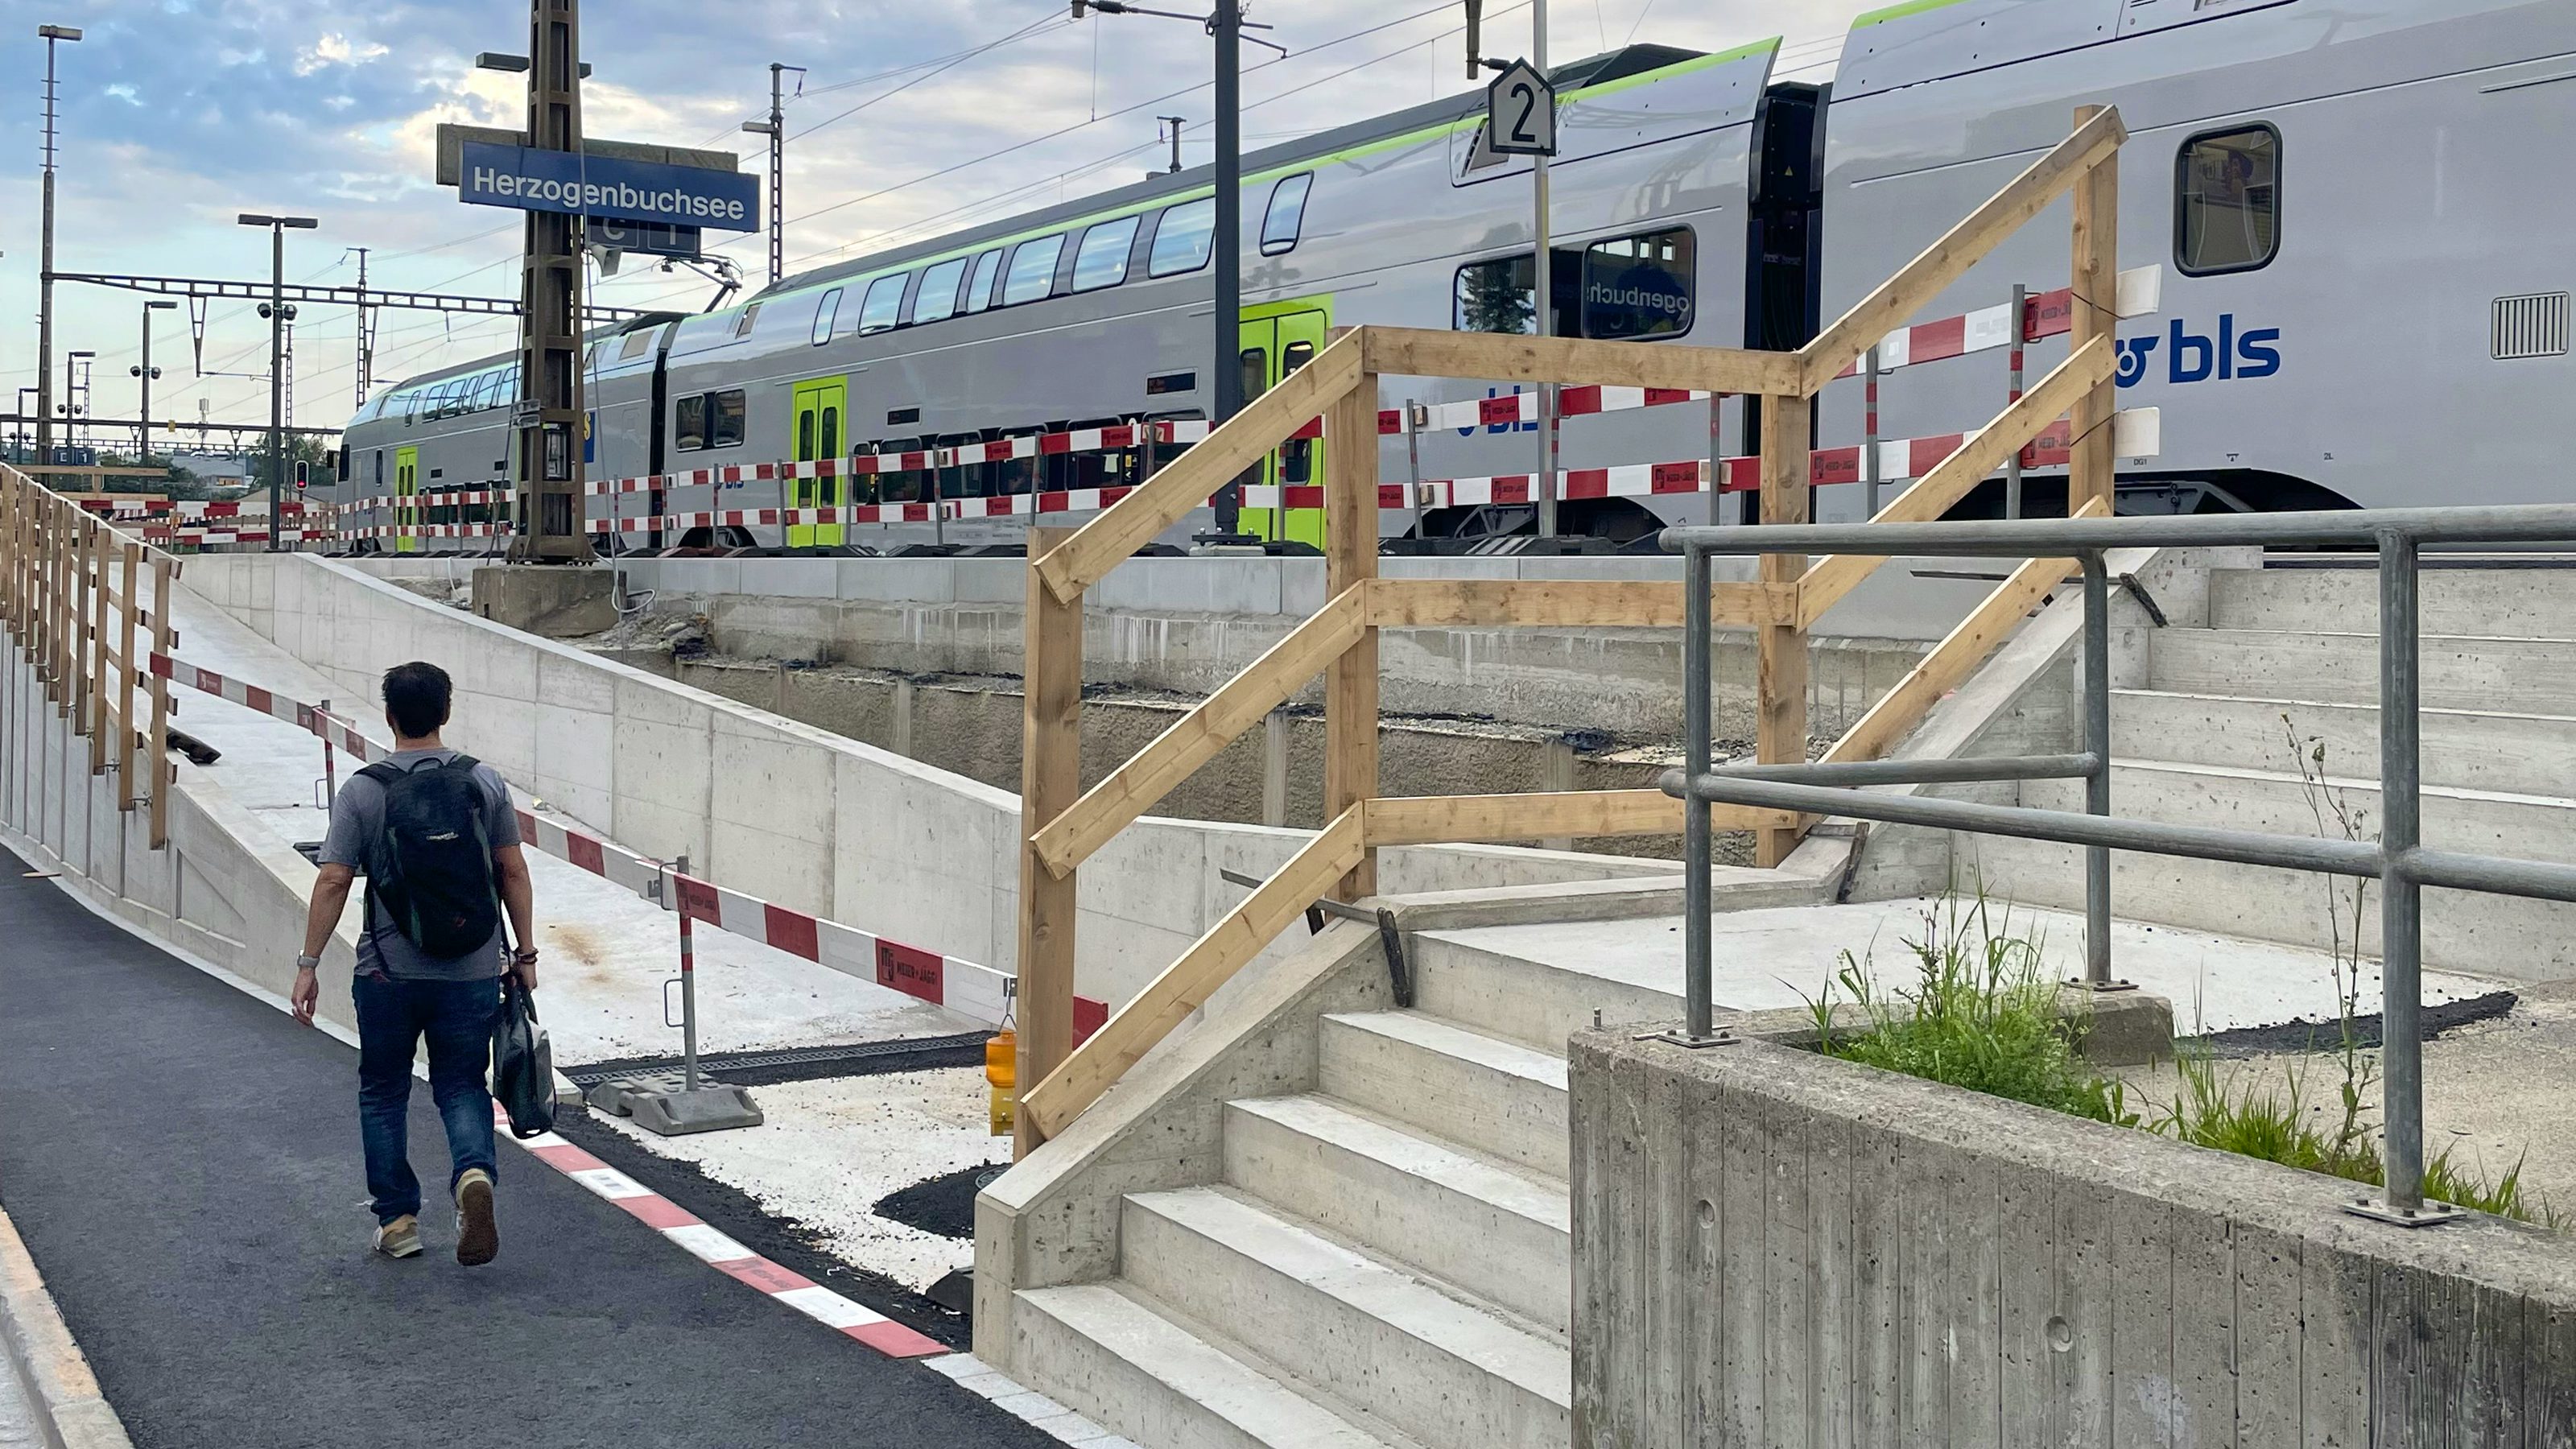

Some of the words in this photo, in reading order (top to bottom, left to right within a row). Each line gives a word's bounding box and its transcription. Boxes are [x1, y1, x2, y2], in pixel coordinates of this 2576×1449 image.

[1511, 83, 1535, 142] 2
[474, 167, 744, 220] Herzogenbuchsee
[2169, 313, 2281, 384] bls
